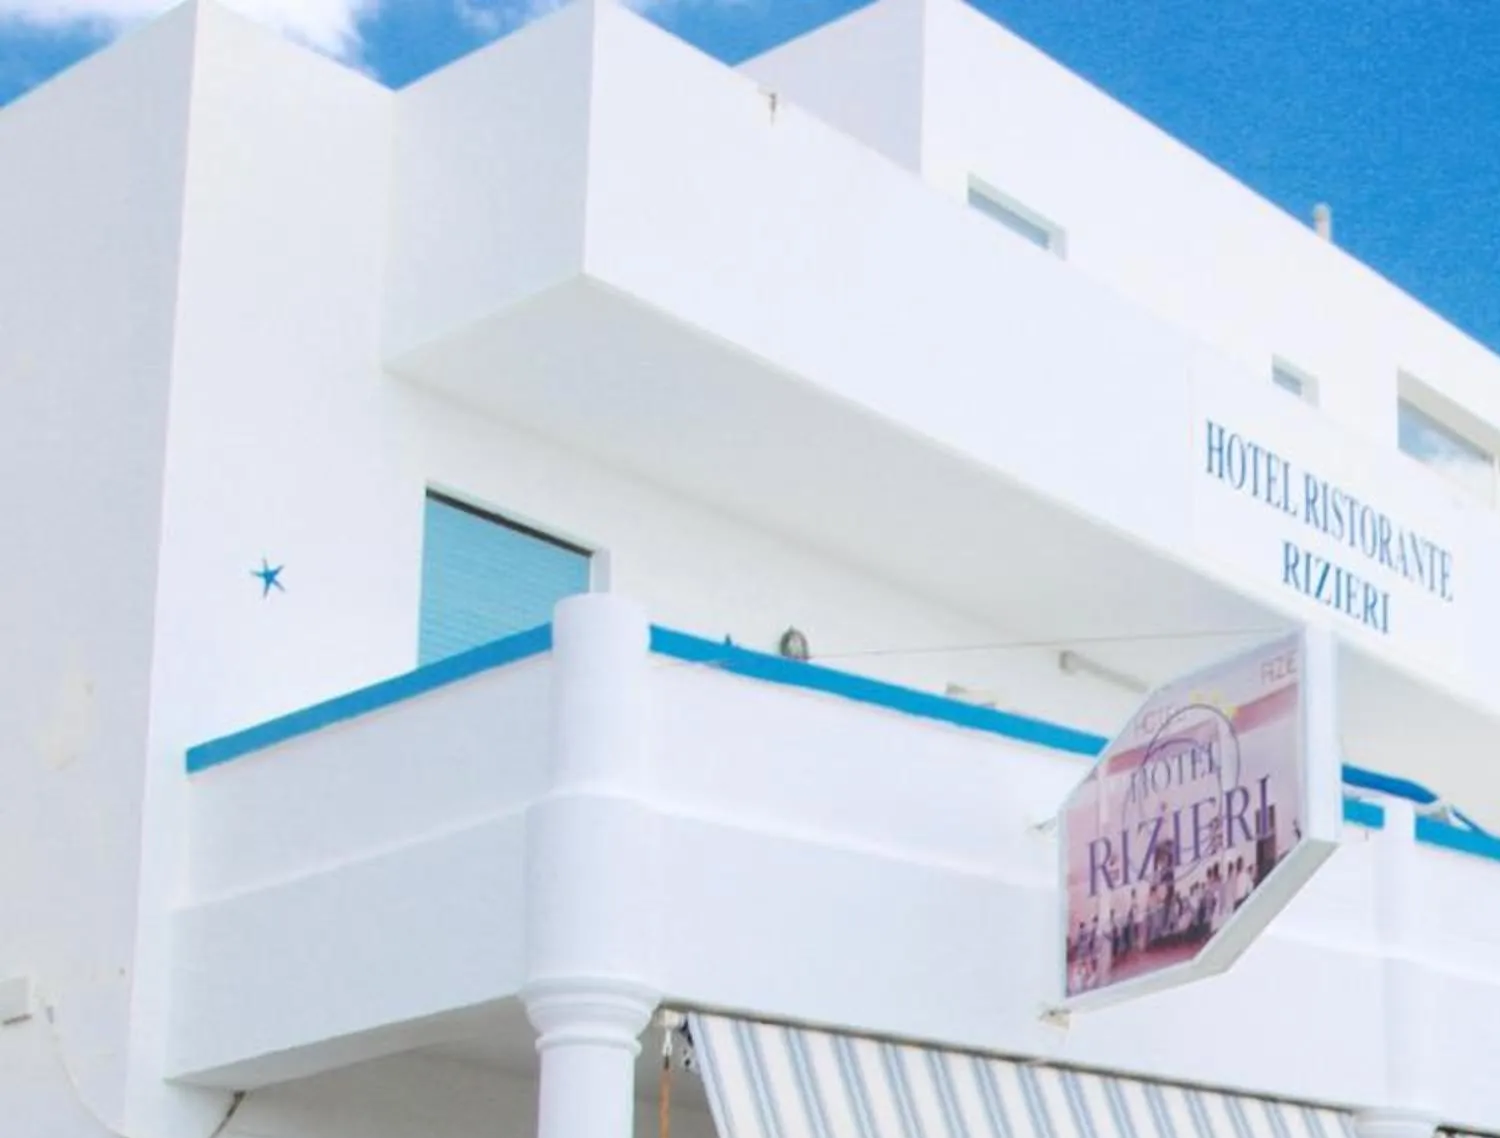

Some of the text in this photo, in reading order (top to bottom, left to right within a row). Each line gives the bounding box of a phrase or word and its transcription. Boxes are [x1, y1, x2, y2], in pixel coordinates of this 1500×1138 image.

[1206, 419, 1454, 603] HOTEL RISTORANTE
[1281, 539, 1390, 635] RIZIERI
[1129, 741, 1221, 802] HOTEL
[1088, 774, 1270, 898] RIZIERI
